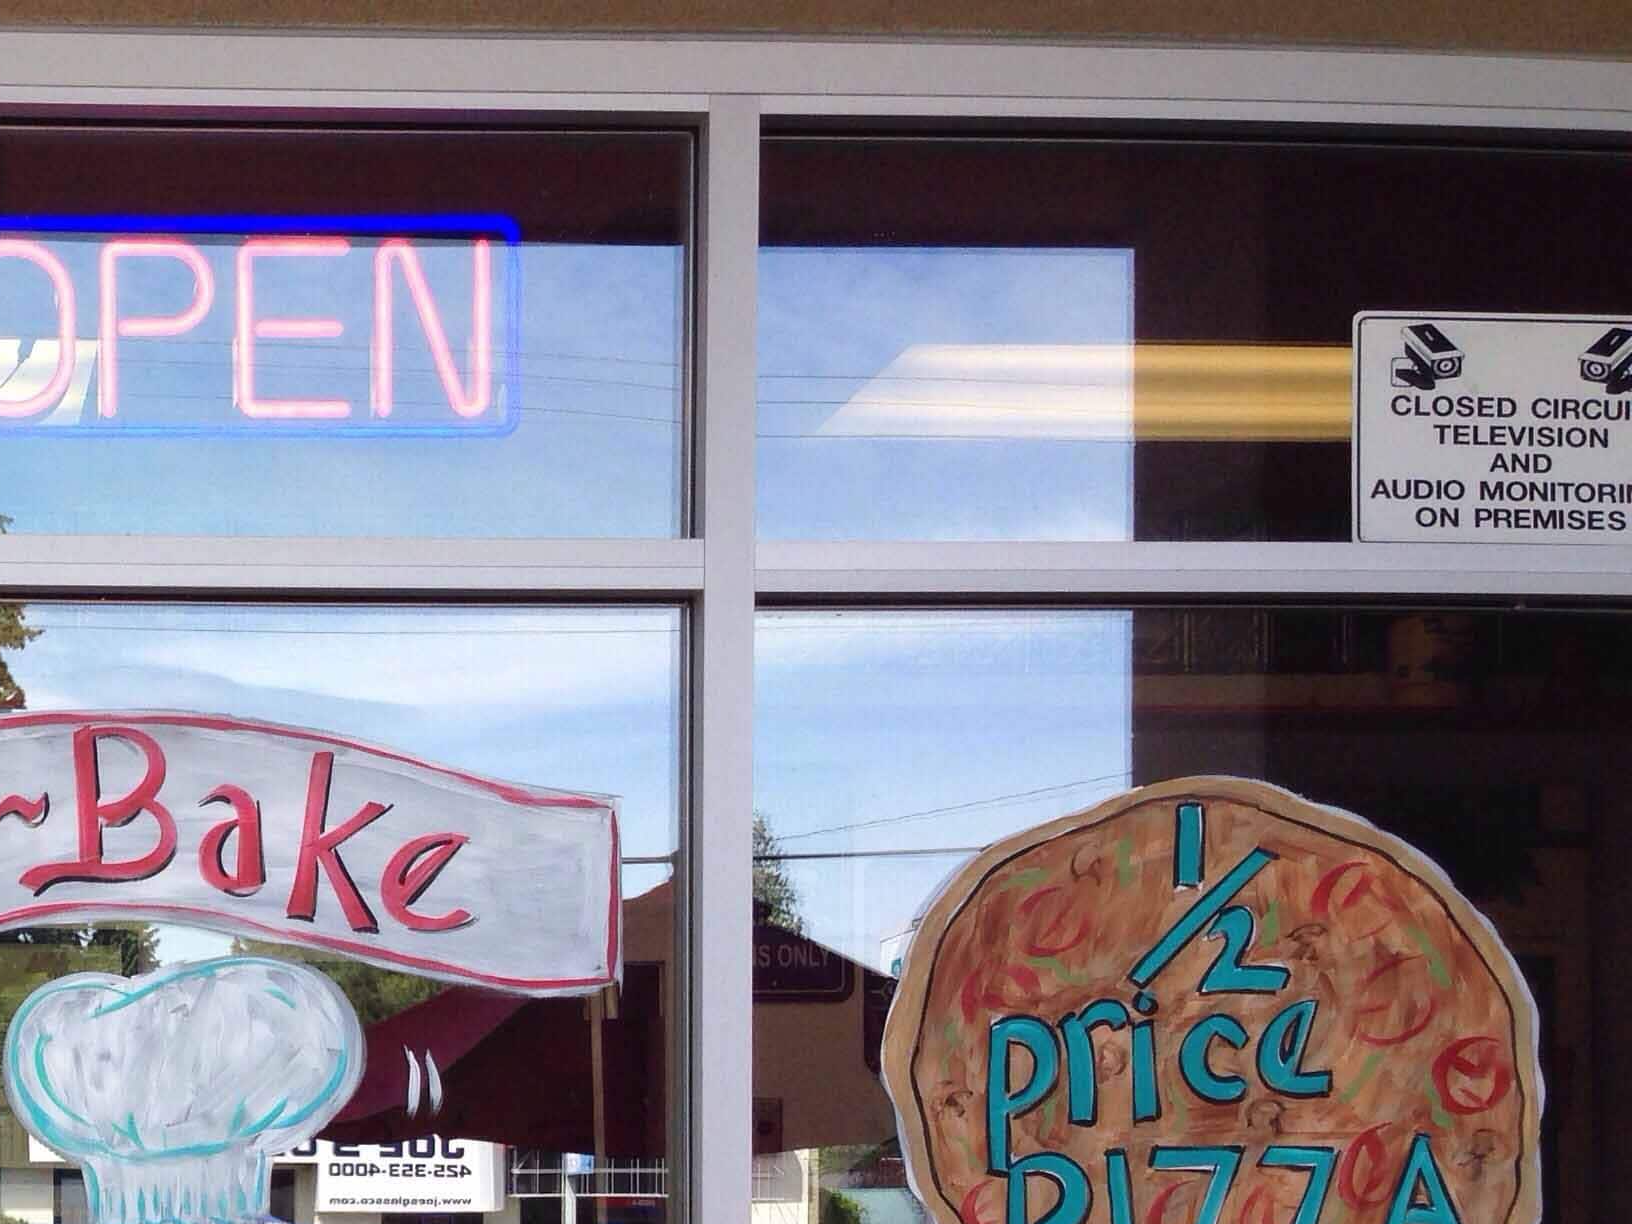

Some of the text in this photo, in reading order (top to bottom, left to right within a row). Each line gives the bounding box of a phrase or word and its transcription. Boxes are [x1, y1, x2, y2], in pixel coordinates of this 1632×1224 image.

[1391, 395, 1517, 418] CLOSED
[1433, 424, 1609, 449] TELEVISION
[1489, 453, 1552, 474] AND
[1370, 479, 1632, 503] AUDIO MONITORI
[1415, 507, 1626, 530] ON PREMISES
